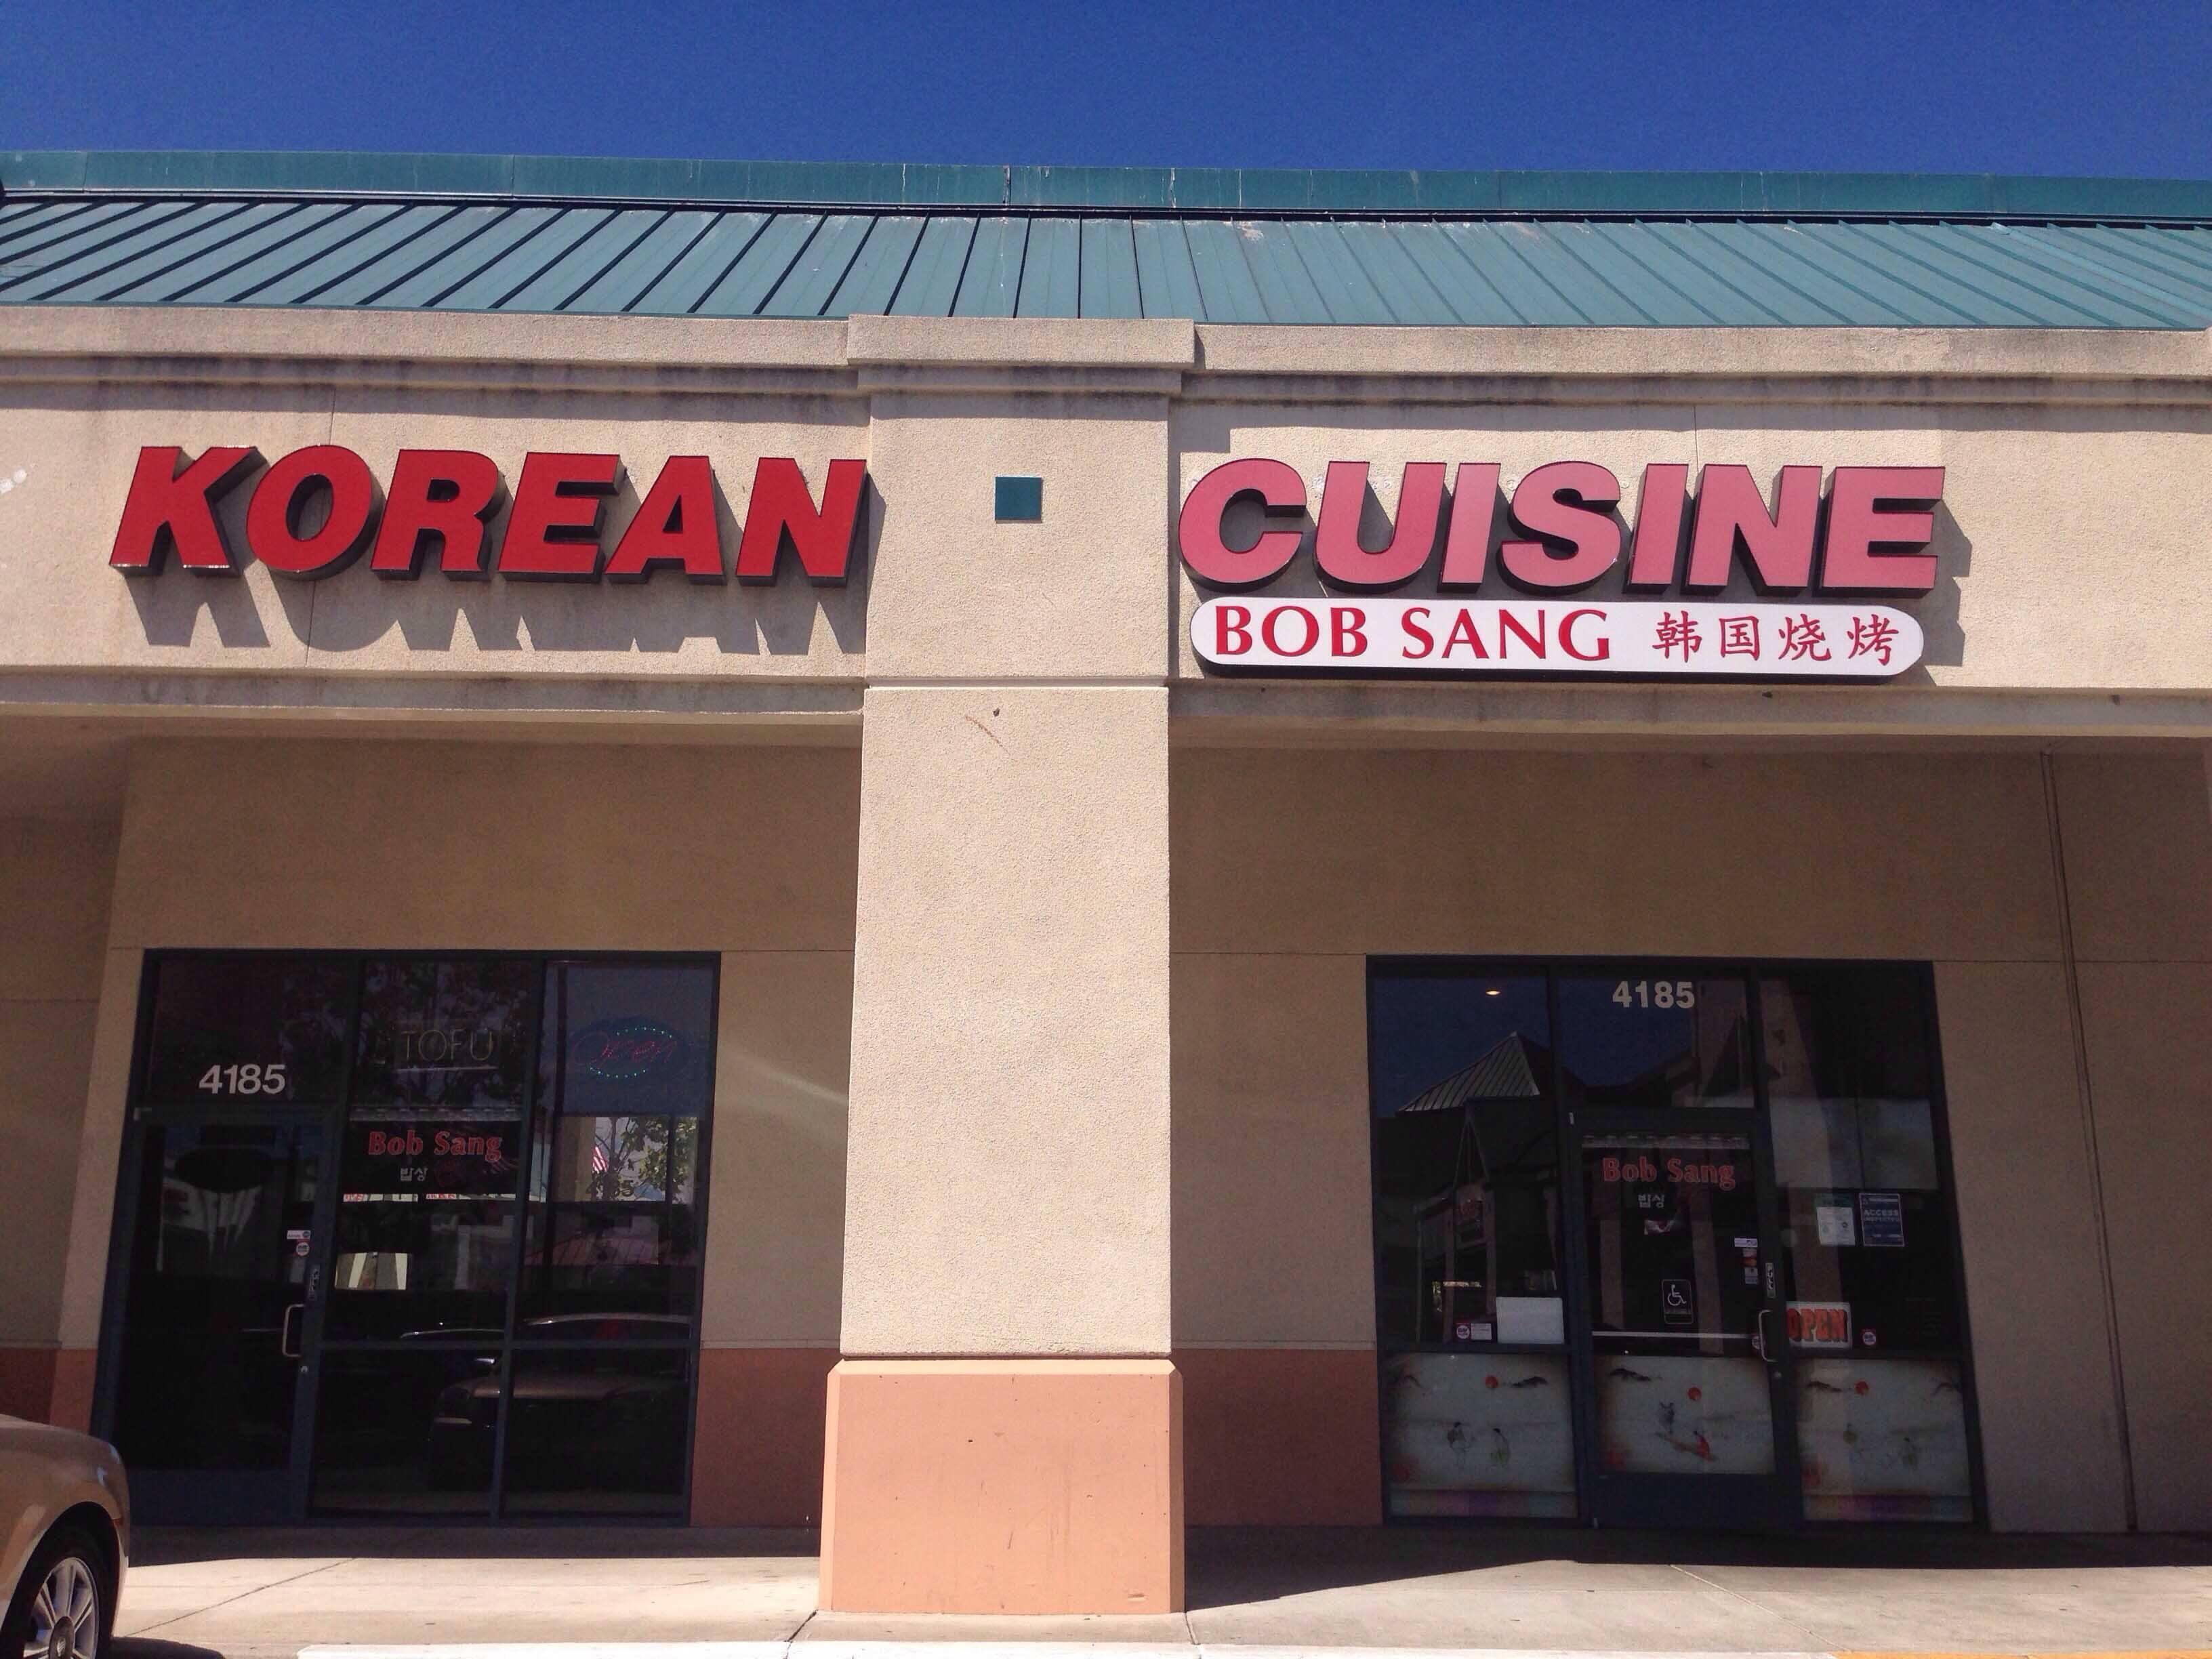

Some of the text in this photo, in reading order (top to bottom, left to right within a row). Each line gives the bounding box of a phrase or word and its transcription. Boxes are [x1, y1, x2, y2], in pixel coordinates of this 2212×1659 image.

[110, 445, 867, 586] KOREAN
[1178, 458, 1945, 594] CUISINE
[1216, 605, 1900, 668] BOB SANG 韩国烧烤
[1612, 981, 1694, 1008] 4185
[401, 1029, 494, 1061] TOFU
[199, 1064, 285, 1094] 4185
[368, 1130, 502, 1163] Bob Sang
[1602, 1156, 1736, 1191] Bob Sang
[1786, 1308, 1845, 1342] OPEN
